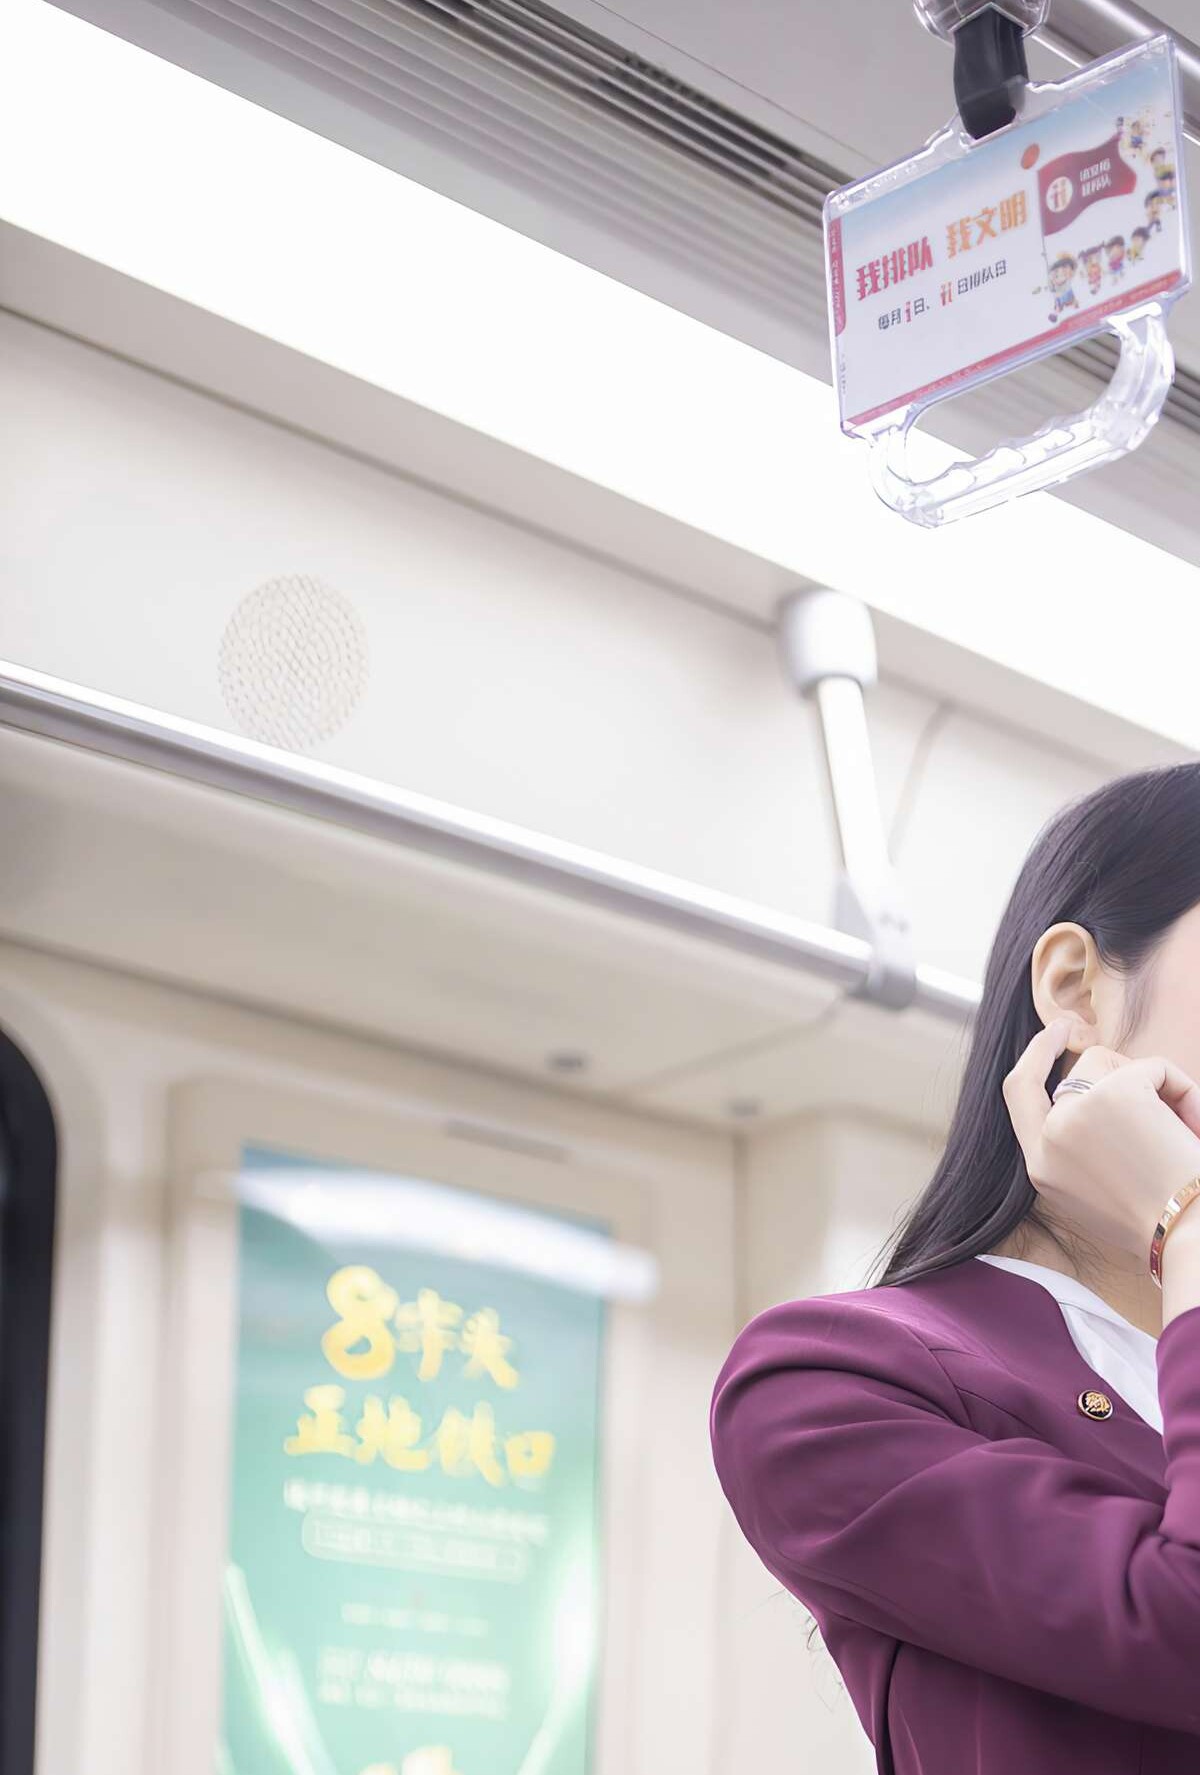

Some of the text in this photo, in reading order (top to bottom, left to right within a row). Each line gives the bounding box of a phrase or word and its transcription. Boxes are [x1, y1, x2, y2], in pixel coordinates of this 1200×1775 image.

[856, 235, 933, 301] 我排队
[946, 189, 1027, 260] 我文明
